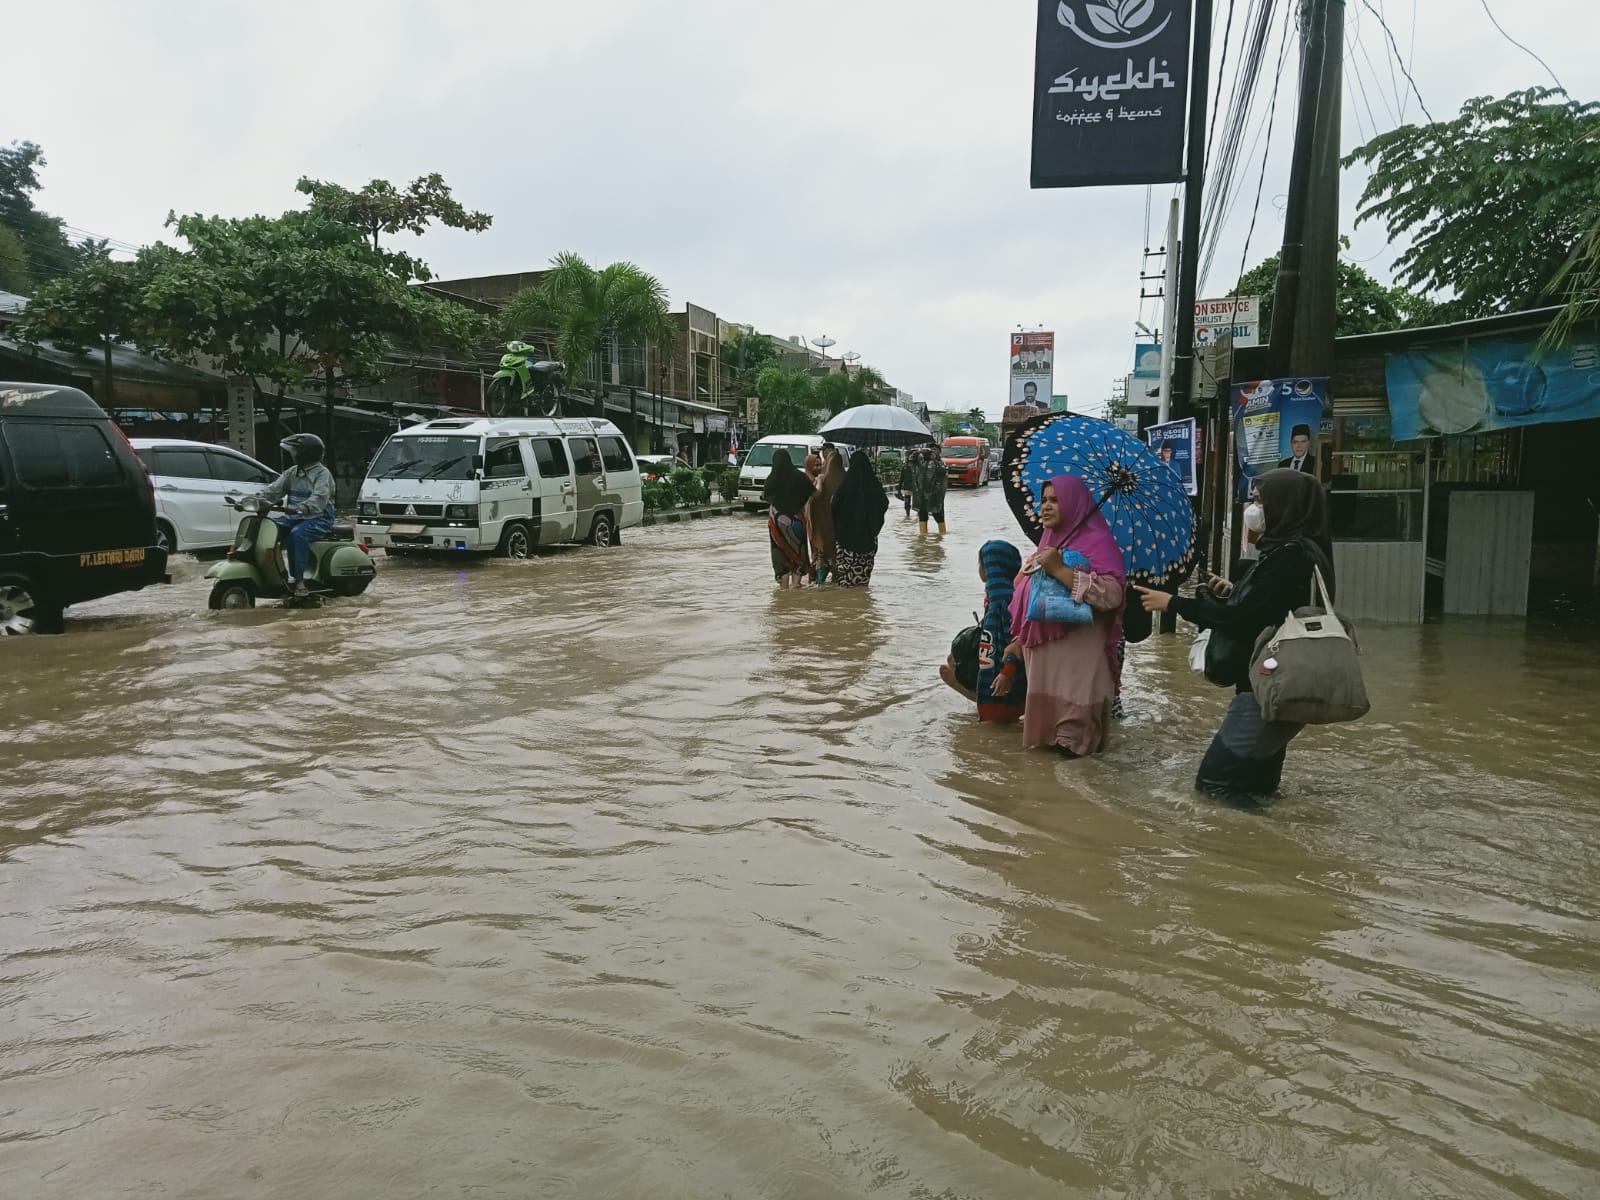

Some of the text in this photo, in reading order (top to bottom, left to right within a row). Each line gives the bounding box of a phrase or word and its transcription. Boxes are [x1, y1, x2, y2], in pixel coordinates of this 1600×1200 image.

[1056, 109, 1102, 125] coffee
[1118, 106, 1163, 121] beans
[1015, 336, 1022, 344] 2
[1281, 383, 1292, 395] 5
[1246, 396, 1269, 408] AMIN
